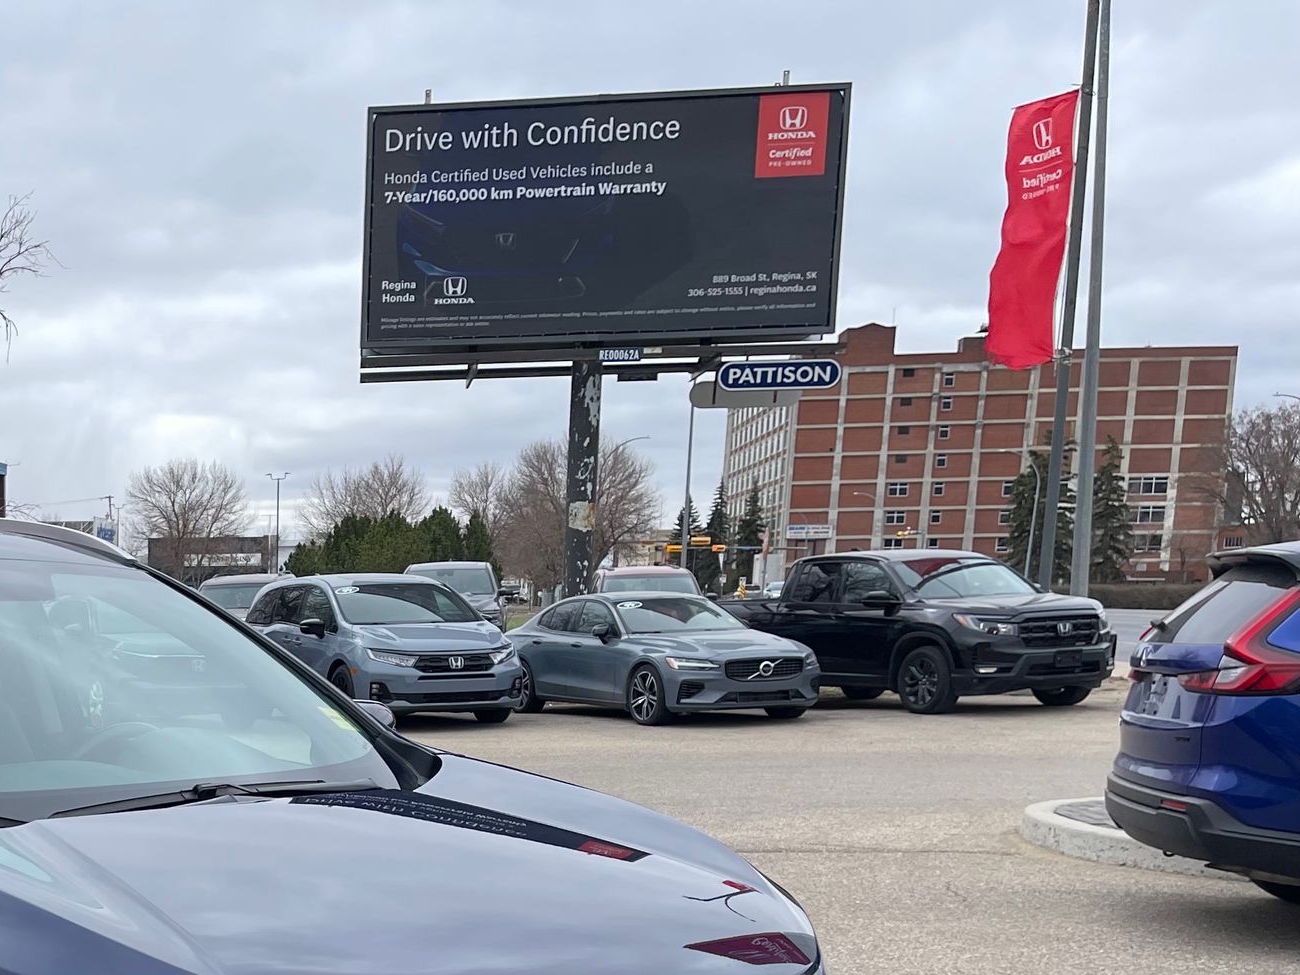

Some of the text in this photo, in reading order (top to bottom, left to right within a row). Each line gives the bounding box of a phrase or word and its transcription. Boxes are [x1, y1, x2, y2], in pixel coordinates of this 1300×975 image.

[385, 116, 680, 152] Drive with Confidence
[768, 130, 816, 140] HONDA
[769, 147, 813, 160] Certified
[384, 161, 654, 184] Honda Certified Used Vehicles include a
[384, 180, 667, 203] 7-Year/160,000 km Powertrain Warranty
[731, 273, 757, 282] Broad
[772, 271, 804, 282] Regina,
[806, 271, 818, 279] SK
[382, 280, 417, 292] Regina
[688, 284, 817, 296] 306-525-1555 reginahonda.ca
[382, 293, 415, 303] Honda
[434, 297, 476, 305] HONDA
[728, 365, 832, 384] PATTISON
